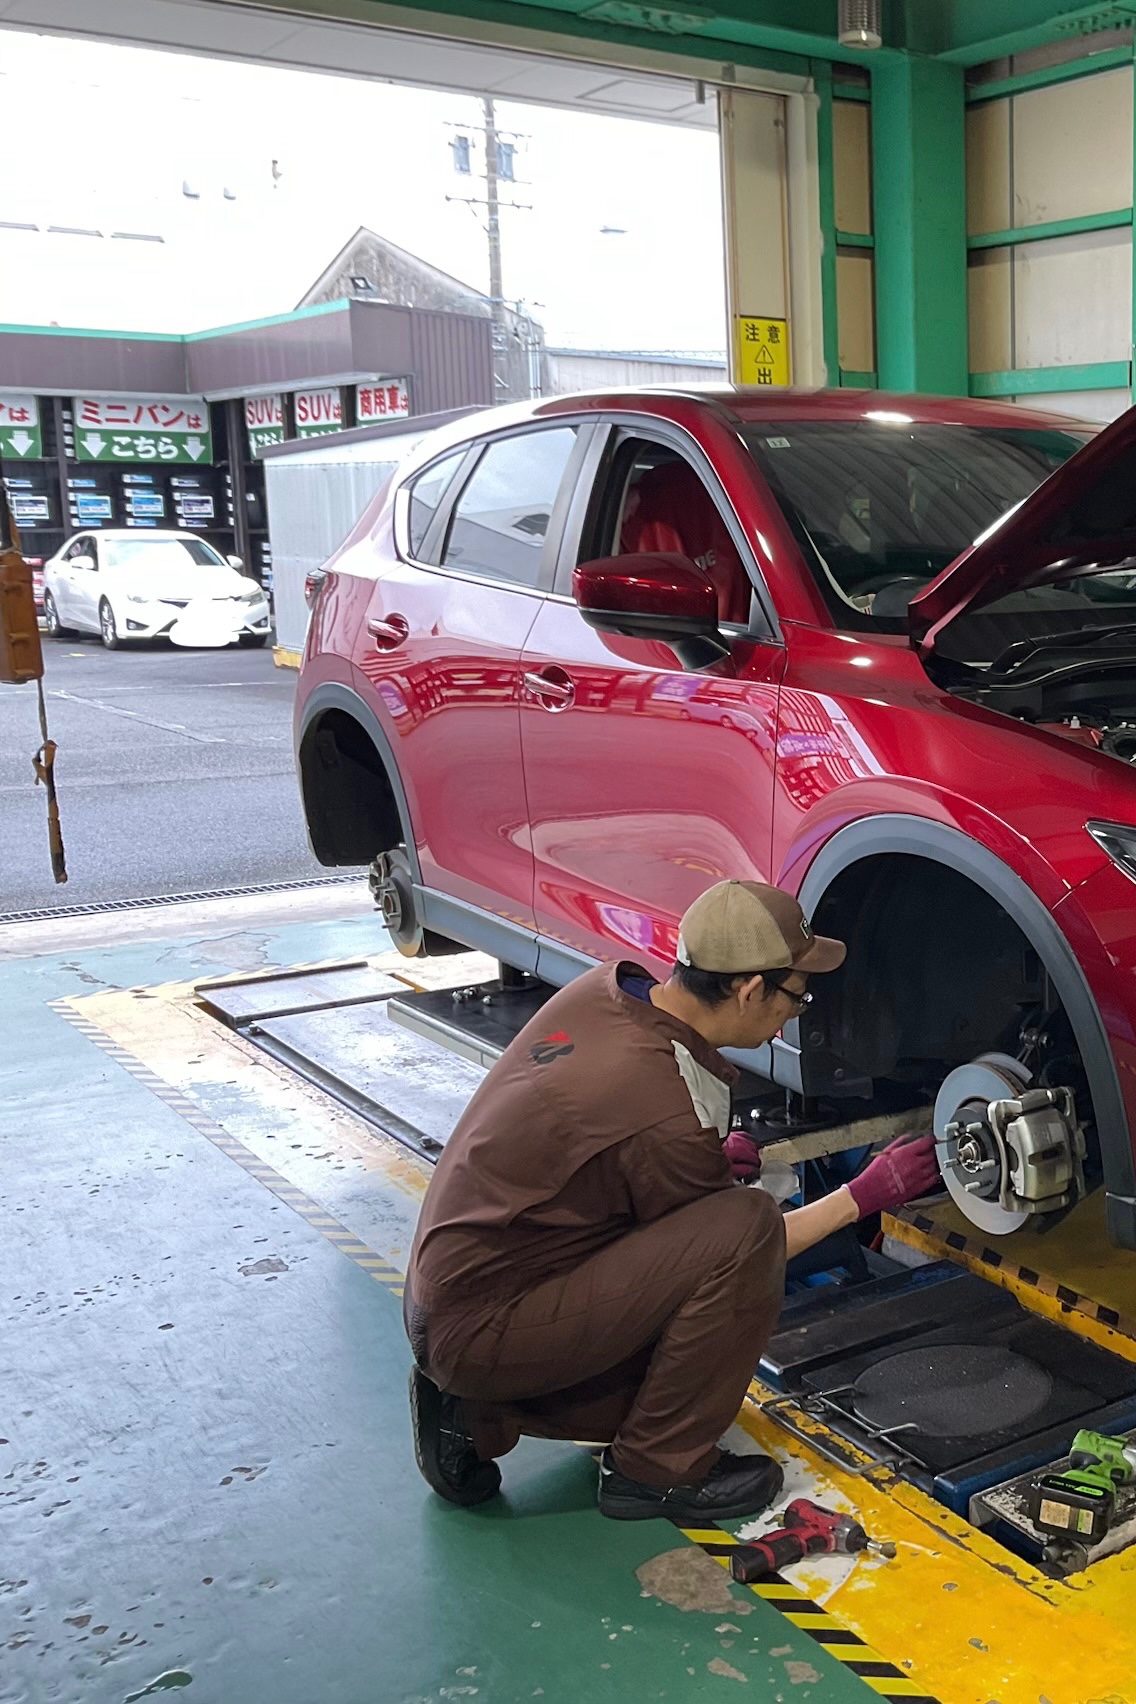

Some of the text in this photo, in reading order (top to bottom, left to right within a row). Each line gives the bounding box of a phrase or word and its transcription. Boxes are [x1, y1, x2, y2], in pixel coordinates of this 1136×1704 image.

[745, 323, 781, 344] 注意
[757, 367, 773, 385] 出
[0, 402, 30, 422] は
[297, 393, 342, 422] SUVは
[359, 384, 408, 417] 商用車は
[81, 399, 202, 429] ミニバンは
[111, 436, 178, 459] こちら
